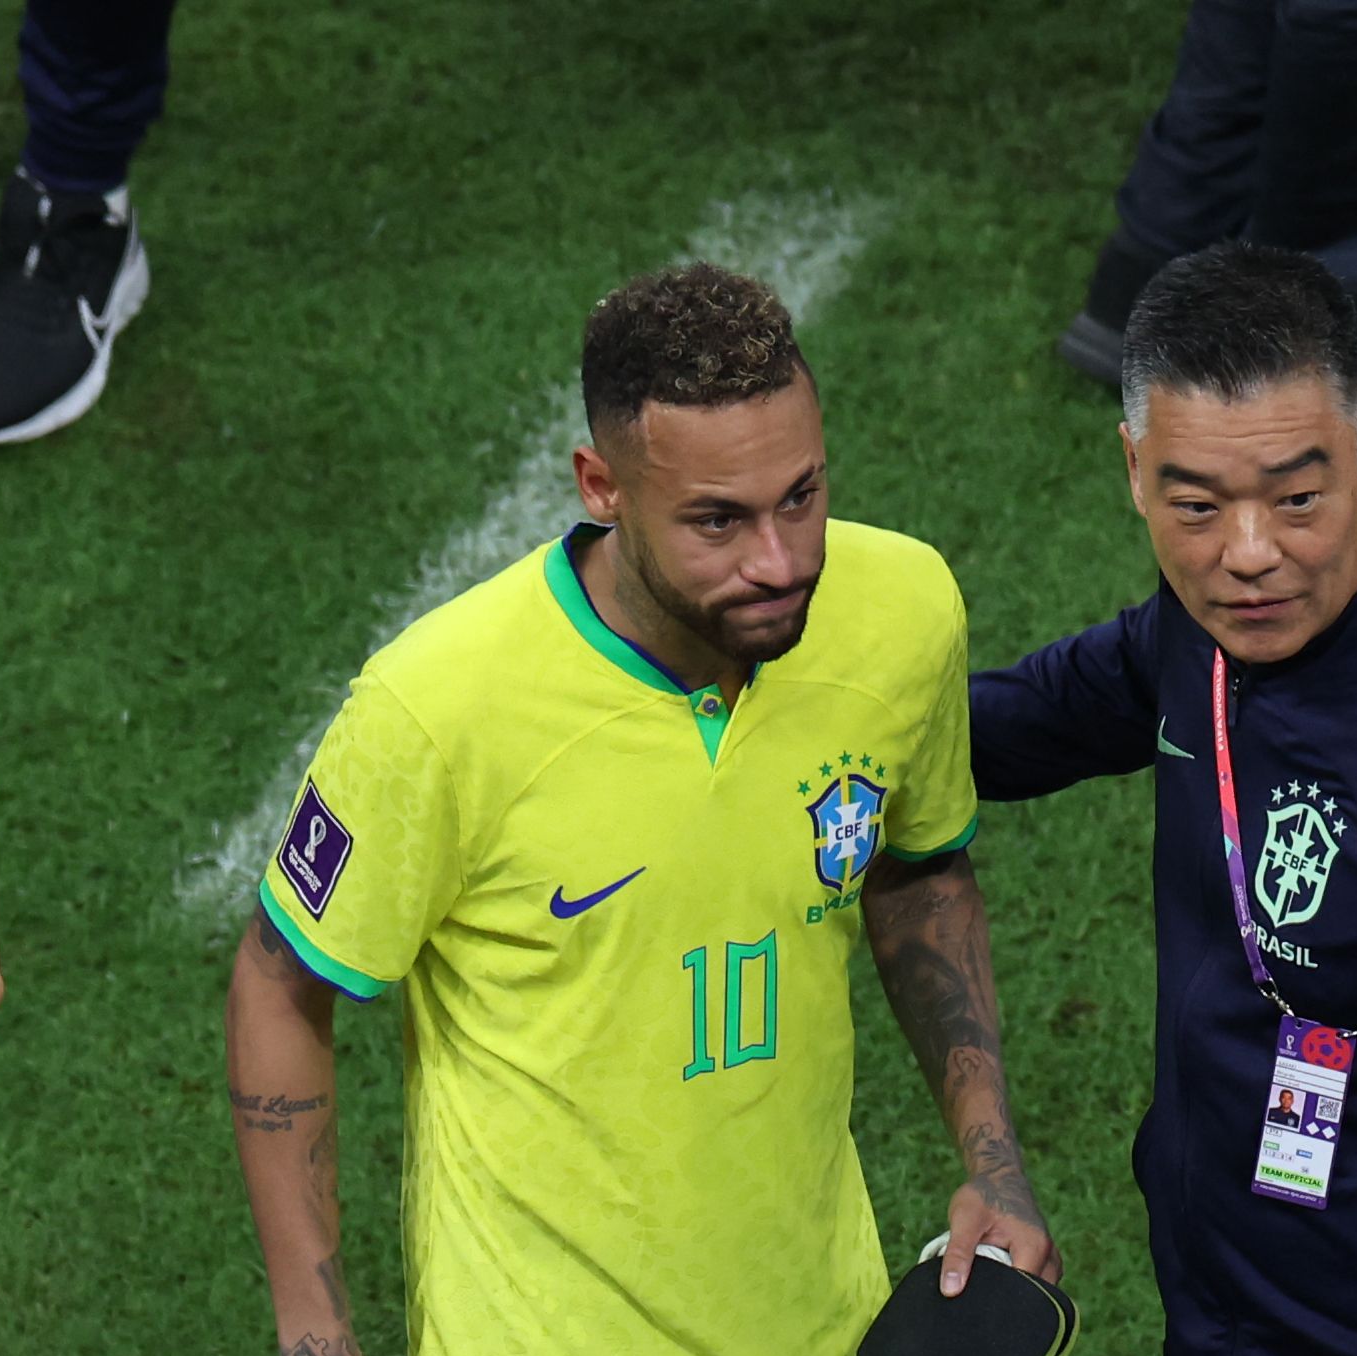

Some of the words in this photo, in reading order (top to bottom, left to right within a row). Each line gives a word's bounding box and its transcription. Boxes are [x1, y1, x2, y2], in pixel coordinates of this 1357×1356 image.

[834, 822, 862, 840] CBF
[1282, 852, 1309, 872] CBF
[683, 928, 778, 1081] 10
[1261, 1166, 1283, 1177] TEAM
[1284, 1172, 1322, 1187] OFFICIAL
